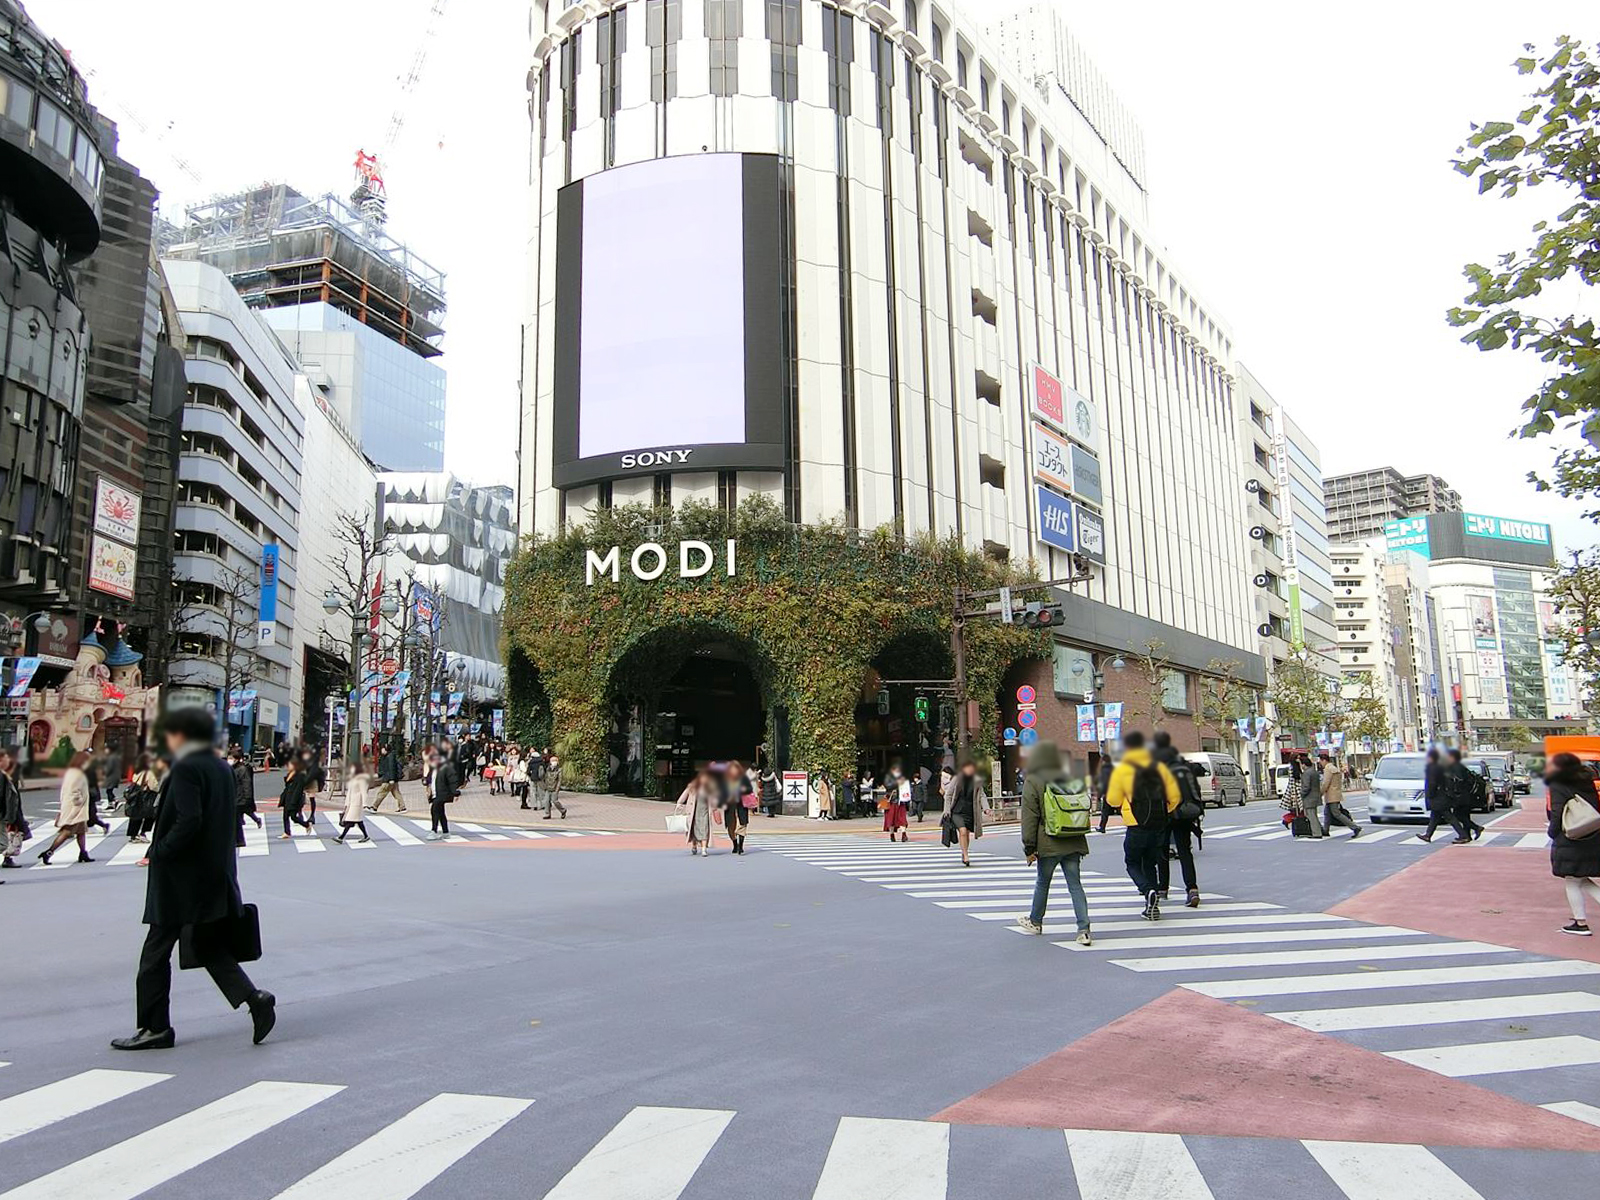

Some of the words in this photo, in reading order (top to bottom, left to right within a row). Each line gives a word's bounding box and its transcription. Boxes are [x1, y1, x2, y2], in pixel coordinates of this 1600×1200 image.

[1041, 379, 1056, 393] HMV
[1038, 396, 1062, 417] BOOKS
[621, 449, 692, 469] SONY
[1045, 440, 1061, 460] エース
[1038, 451, 1068, 477] コンタクト
[1386, 519, 1426, 538] ニトリ
[1467, 513, 1496, 535] ニトリ
[1500, 520, 1545, 541] NITORI
[1387, 534, 1427, 548] NITORI
[585, 538, 736, 586] MODI
[261, 628, 271, 640] P
[448, 682, 456, 692] 6
[1083, 690, 1093, 703] 5
[787, 780, 804, 799] 本
